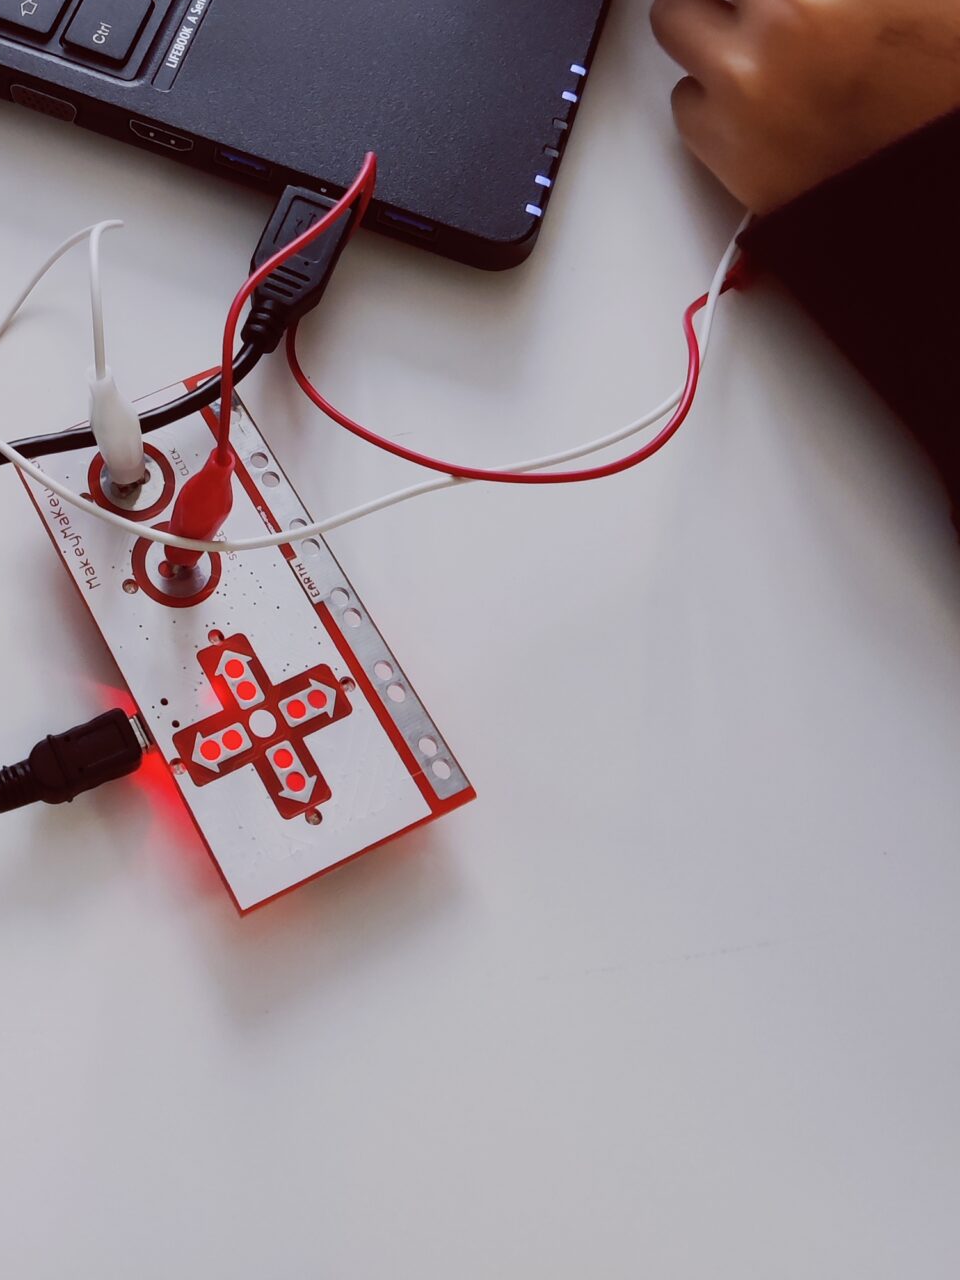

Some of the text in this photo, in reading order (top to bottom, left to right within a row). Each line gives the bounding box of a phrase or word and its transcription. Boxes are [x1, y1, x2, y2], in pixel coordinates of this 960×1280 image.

[92, 22, 113, 45] Ctrl
[165, 25, 194, 70] LIFEBOOK
[187, 14, 200, 25] A
[168, 447, 190, 477] CLICK
[215, 529, 238, 562] SCE
[294, 563, 321, 599] EARTH
